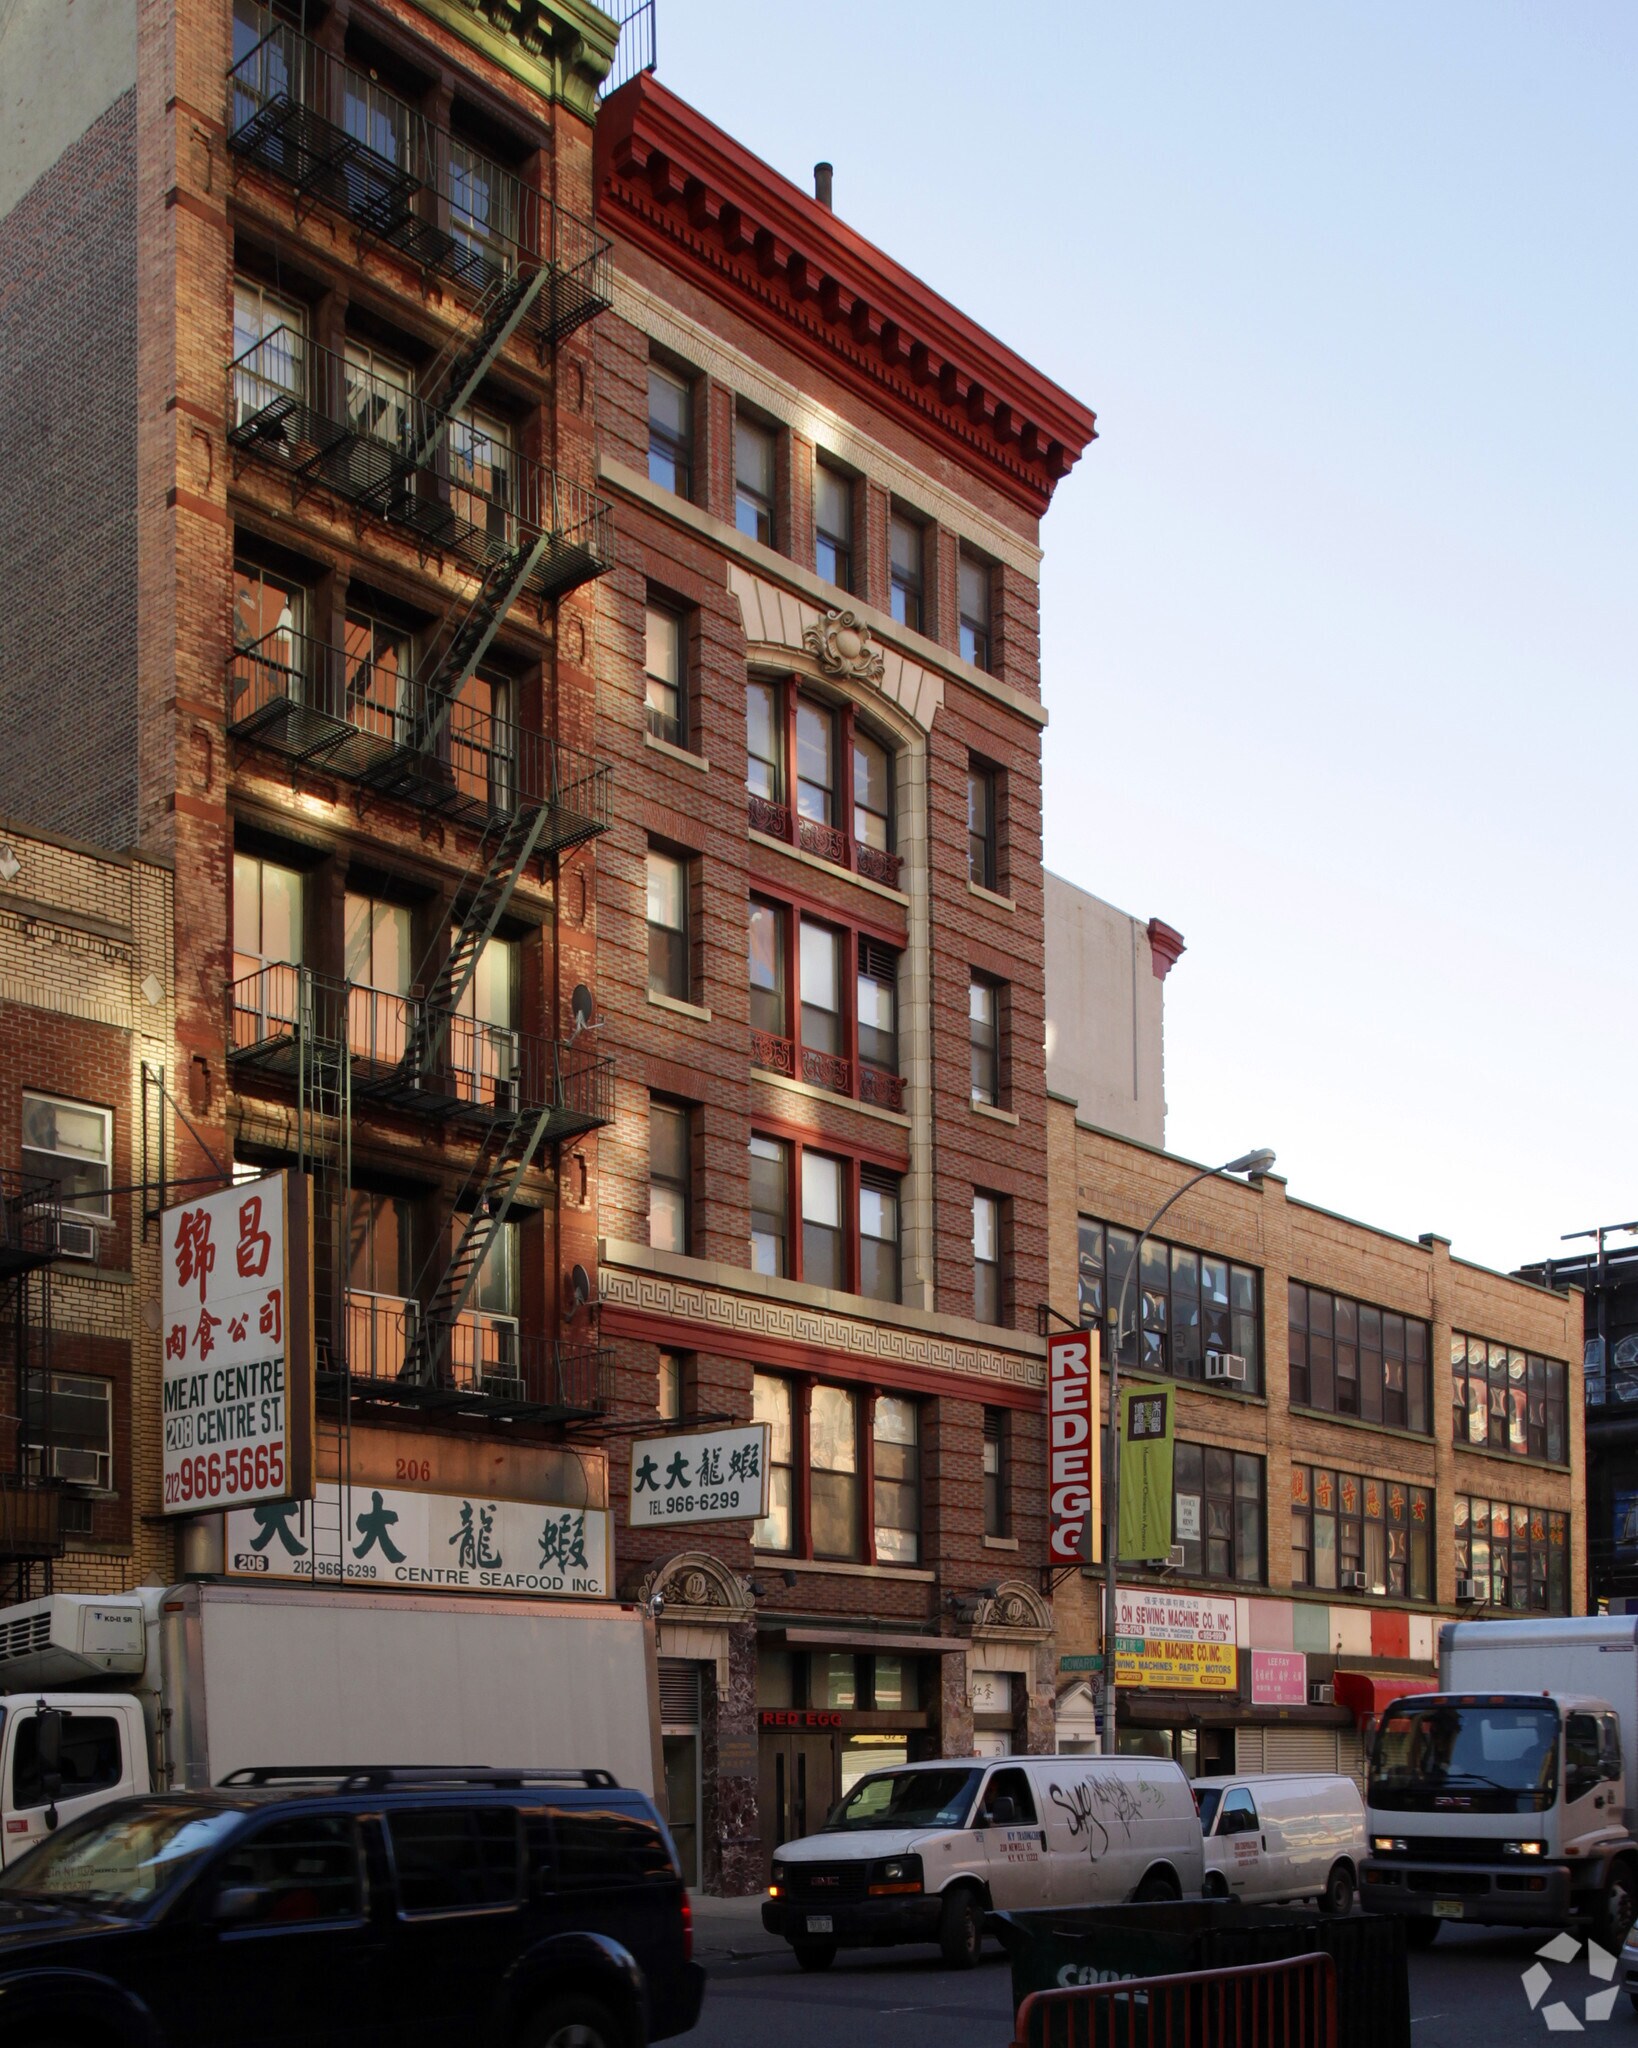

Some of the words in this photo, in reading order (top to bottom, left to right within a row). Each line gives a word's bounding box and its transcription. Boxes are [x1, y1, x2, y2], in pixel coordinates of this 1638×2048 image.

[174, 1196, 271, 1304] 錦昌
[166, 1289, 281, 1361] 肉食公司
[164, 1374, 208, 1413] MEAT
[214, 1358, 284, 1403] CENTRE
[167, 1415, 193, 1451] 208
[197, 1402, 256, 1445] CENTRE
[261, 1397, 283, 1434] ST.
[165, 1472, 180, 1504] 212
[181, 1441, 284, 1501] 966-5665
[396, 1458, 431, 1482] 206
[634, 1443, 760, 1493] 大大龍蝦
[649, 1500, 665, 1515] TEL.
[666, 1490, 740, 1514] 966-6299
[238, 1554, 266, 1572] 206
[293, 1560, 377, 1578] 212-966-6299
[395, 1566, 469, 1585] CENTRE
[479, 1572, 563, 1590] SEAFOOD
[572, 1578, 602, 1593] INC.
[1121, 1605, 1133, 1622] ON
[1136, 1607, 1165, 1625] SEWING
[1168, 1610, 1199, 1628] MACHINE
[1202, 1612, 1214, 1629] CO.
[1217, 1614, 1231, 1631] INC.
[1116, 1639, 1136, 1652] CENTRE
[1165, 1643, 1194, 1660] MACHINE
[1062, 1657, 1096, 1670] HOWARD
[1138, 1661, 1173, 1671] MACHINES
[1179, 1663, 1199, 1673] PARTS
[1205, 1665, 1231, 1674] MOTORS
[1268, 1657, 1278, 1666] LEE
[1279, 1658, 1290, 1666] FAY
[763, 1712, 799, 1725] RED
[805, 1712, 842, 1726] EGG
